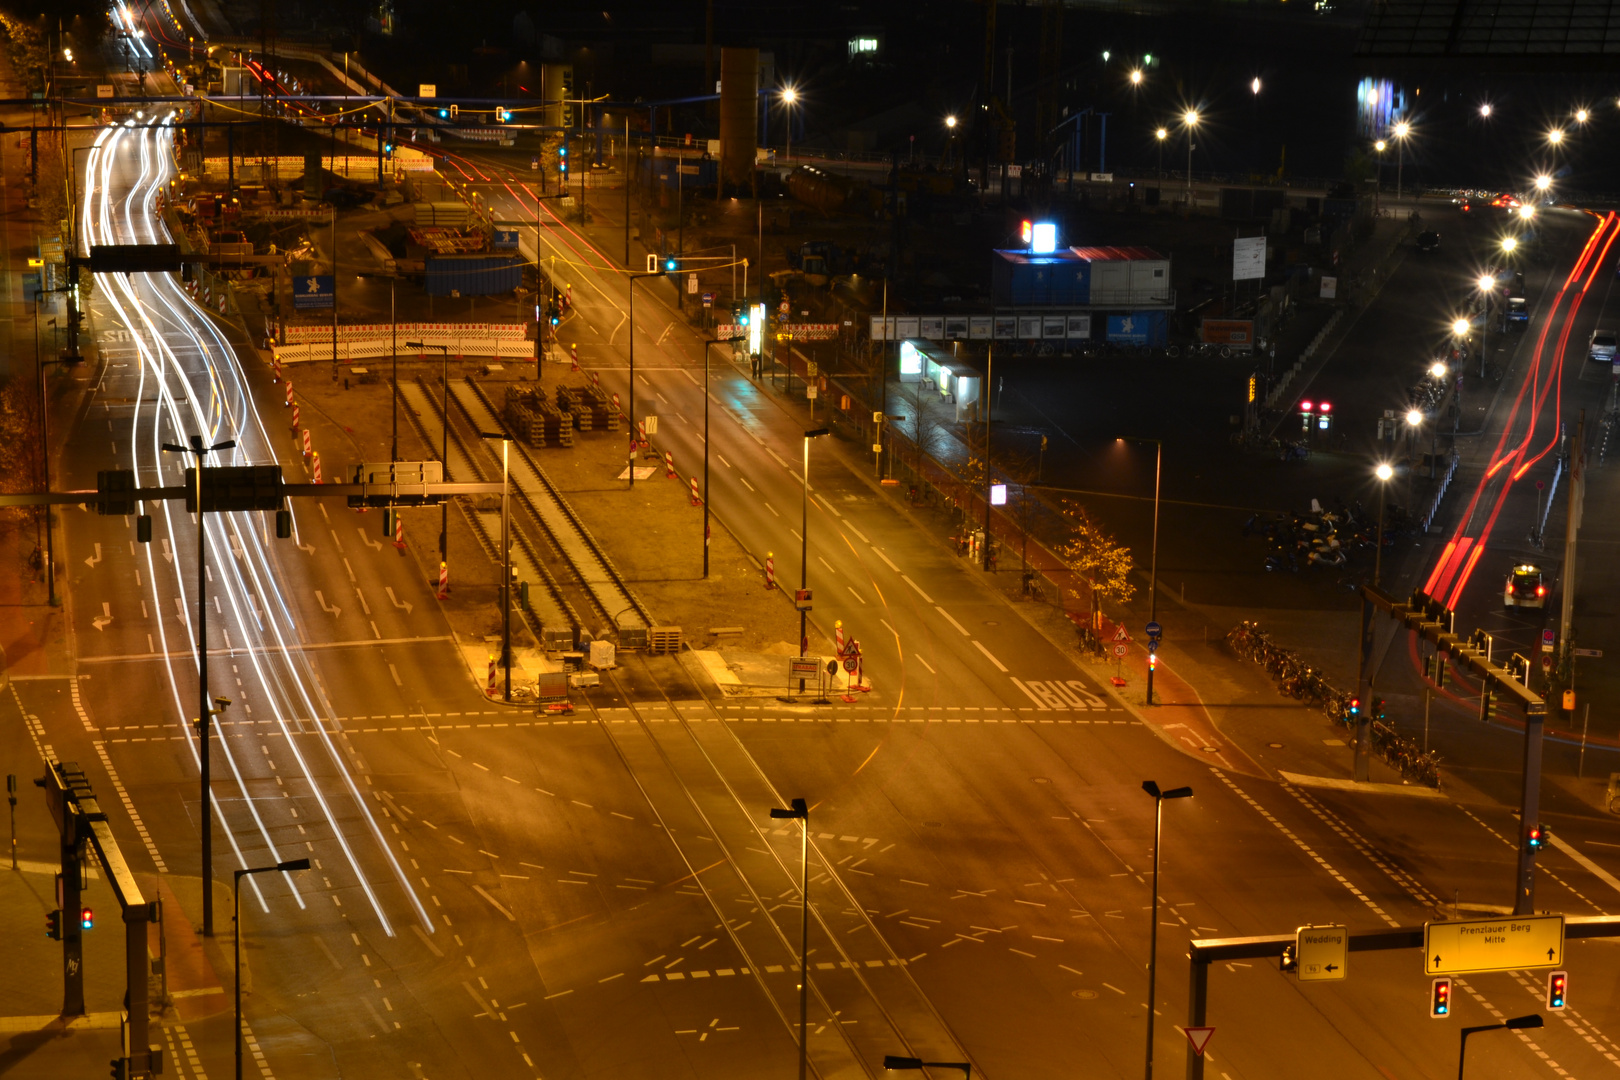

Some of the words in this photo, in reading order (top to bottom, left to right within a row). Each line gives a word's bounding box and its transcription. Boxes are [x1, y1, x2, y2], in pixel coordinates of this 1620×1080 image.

[1116, 646, 1125, 654] 30
[846, 661, 855, 669] 30
[1025, 680, 1108, 708] BUS
[1460, 925, 1507, 935] Prenzlauer
[1510, 923, 1531, 933] Berg
[1304, 935, 1342, 945] Wedding
[1484, 936, 1506, 944] Mitte
